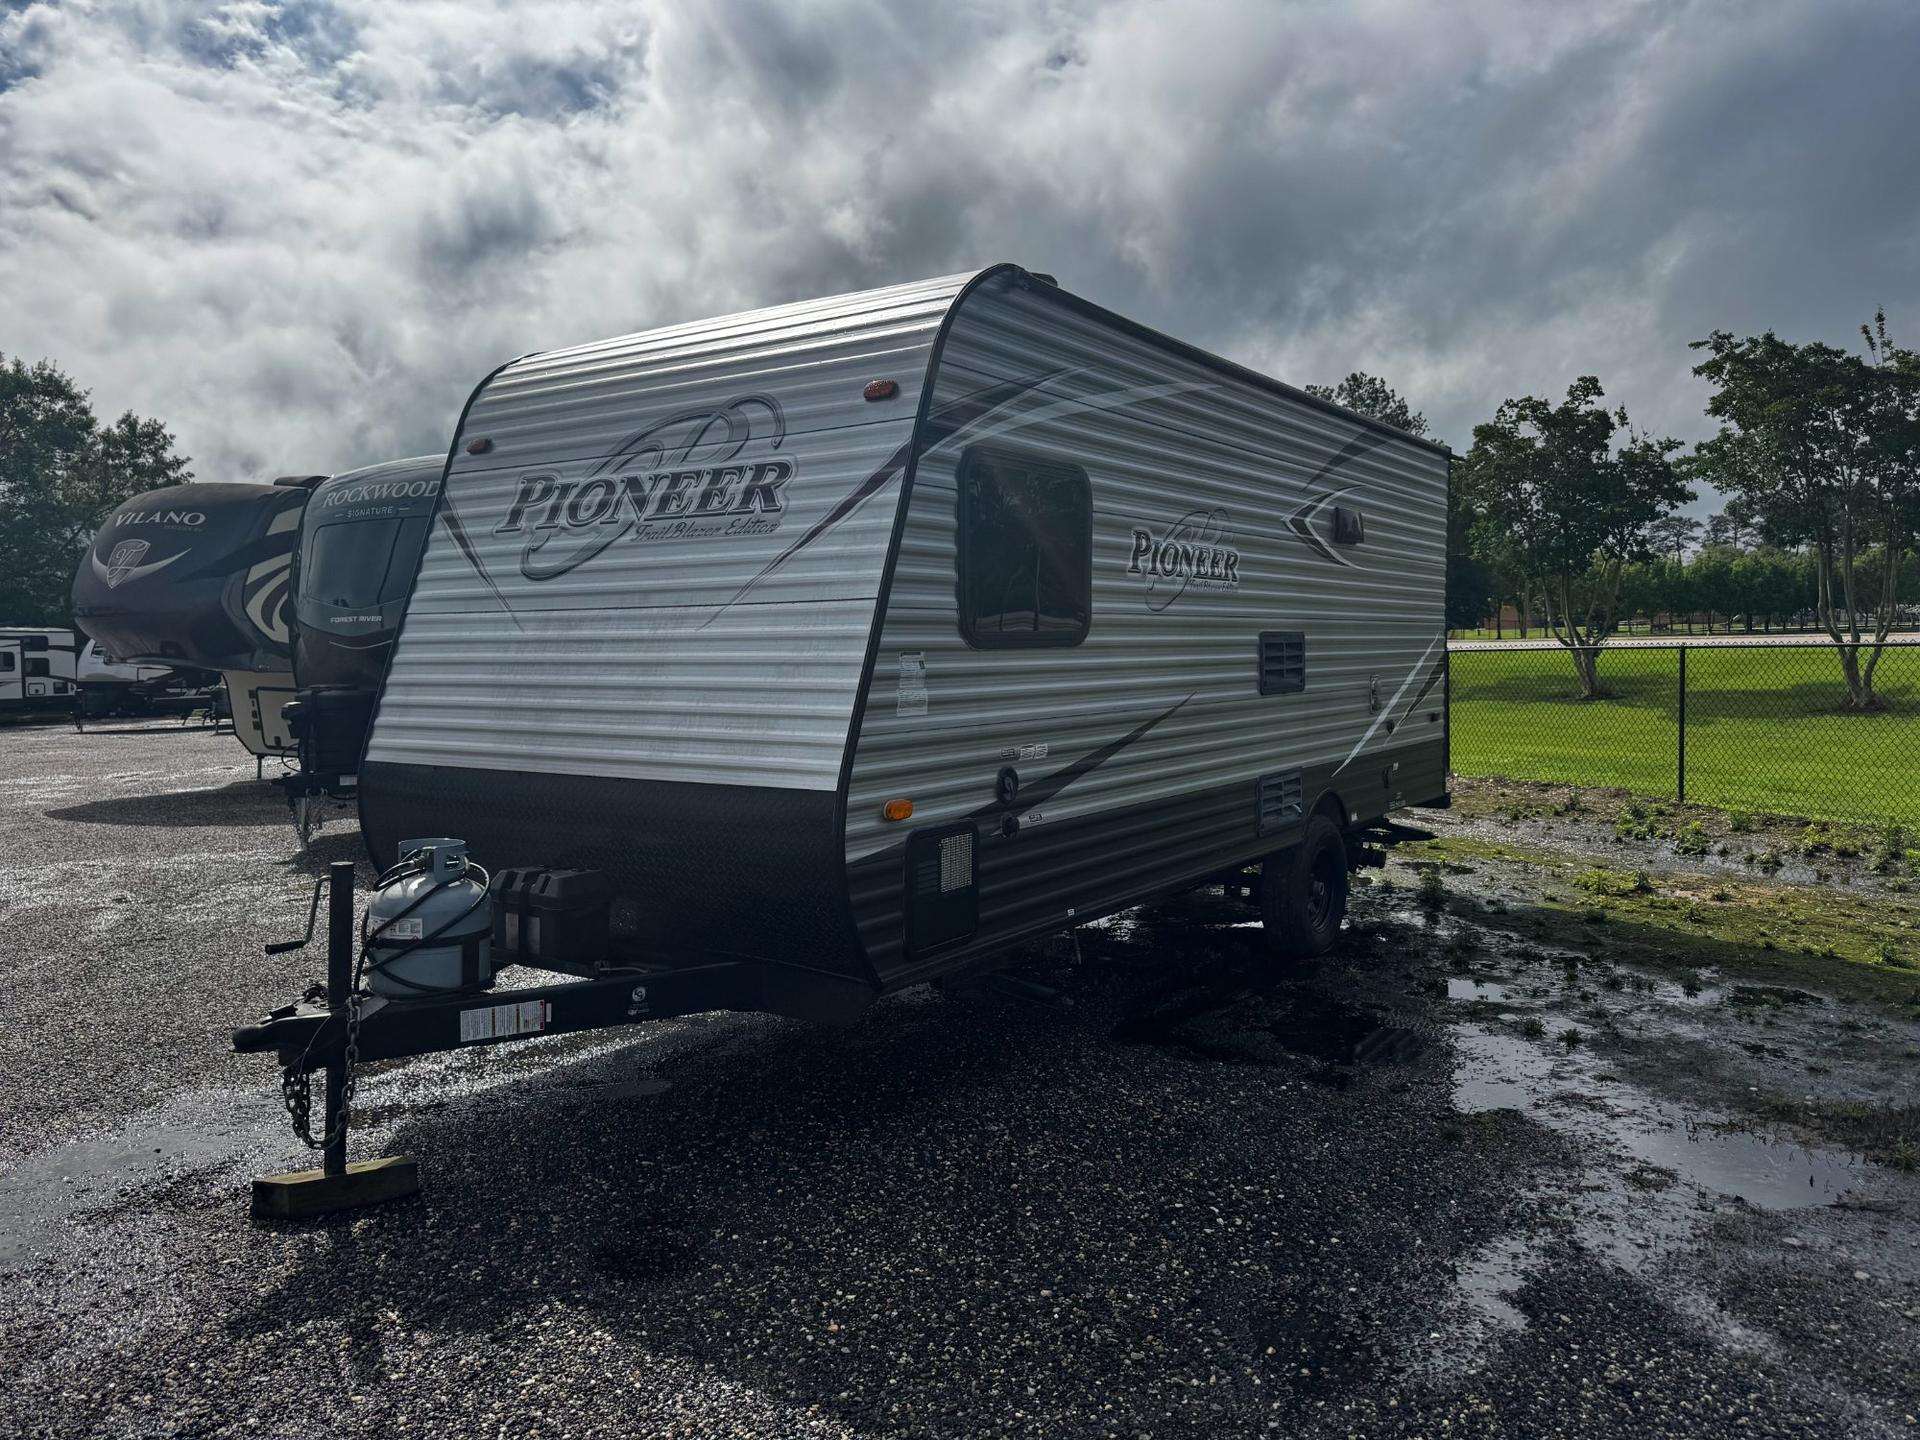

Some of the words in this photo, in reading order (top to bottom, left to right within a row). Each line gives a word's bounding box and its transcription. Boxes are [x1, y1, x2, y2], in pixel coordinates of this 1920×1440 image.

[322, 480, 438, 508] ROCKWOOD
[495, 460, 793, 534] PIONEER
[115, 510, 206, 527] VILANO
[346, 506, 394, 518] SIGNATURE
[725, 517, 779, 536] Edition
[1127, 530, 1239, 582] PIONEER
[330, 616, 357, 624] FOREST
